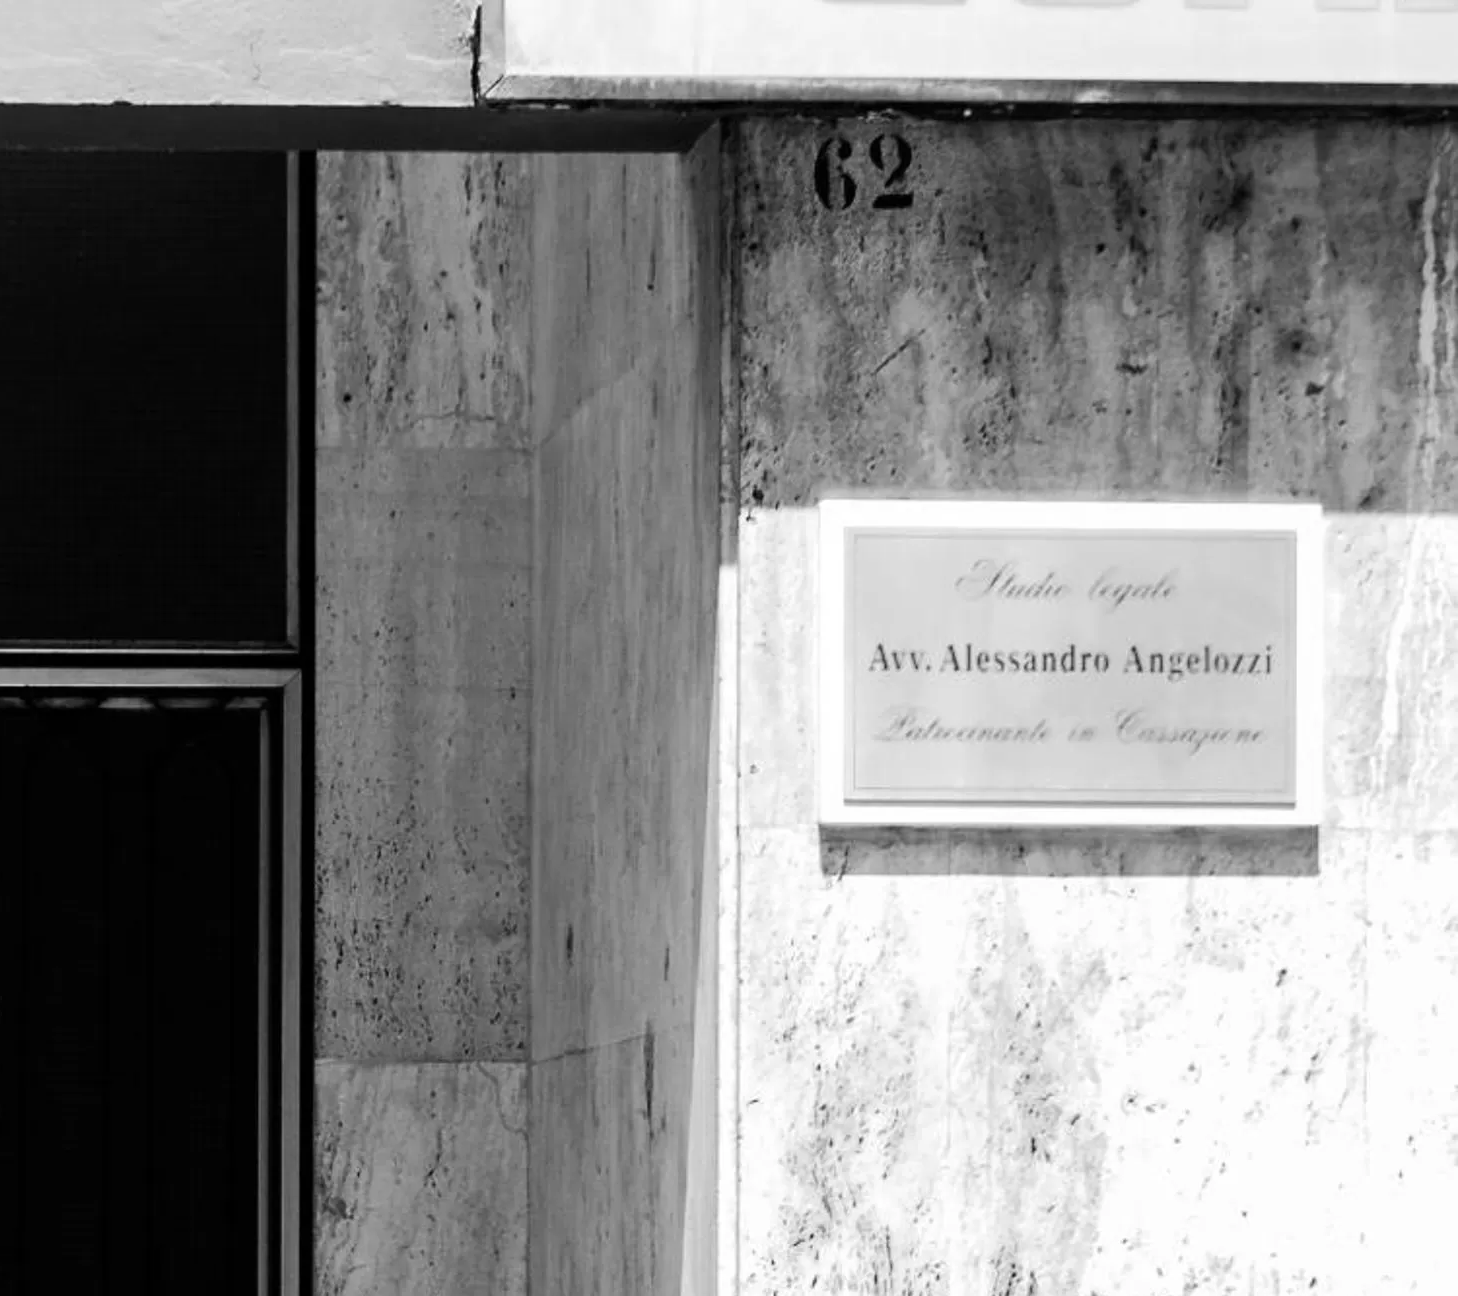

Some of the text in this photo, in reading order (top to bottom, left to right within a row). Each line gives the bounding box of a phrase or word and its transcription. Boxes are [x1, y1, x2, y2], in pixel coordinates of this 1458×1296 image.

[812, 133, 915, 211] 62
[954, 557, 1181, 613] Studio legale
[868, 642, 1273, 682] Avv. Alessandro Angelozzi
[873, 704, 1266, 756] Patrocinante in Cassazione
